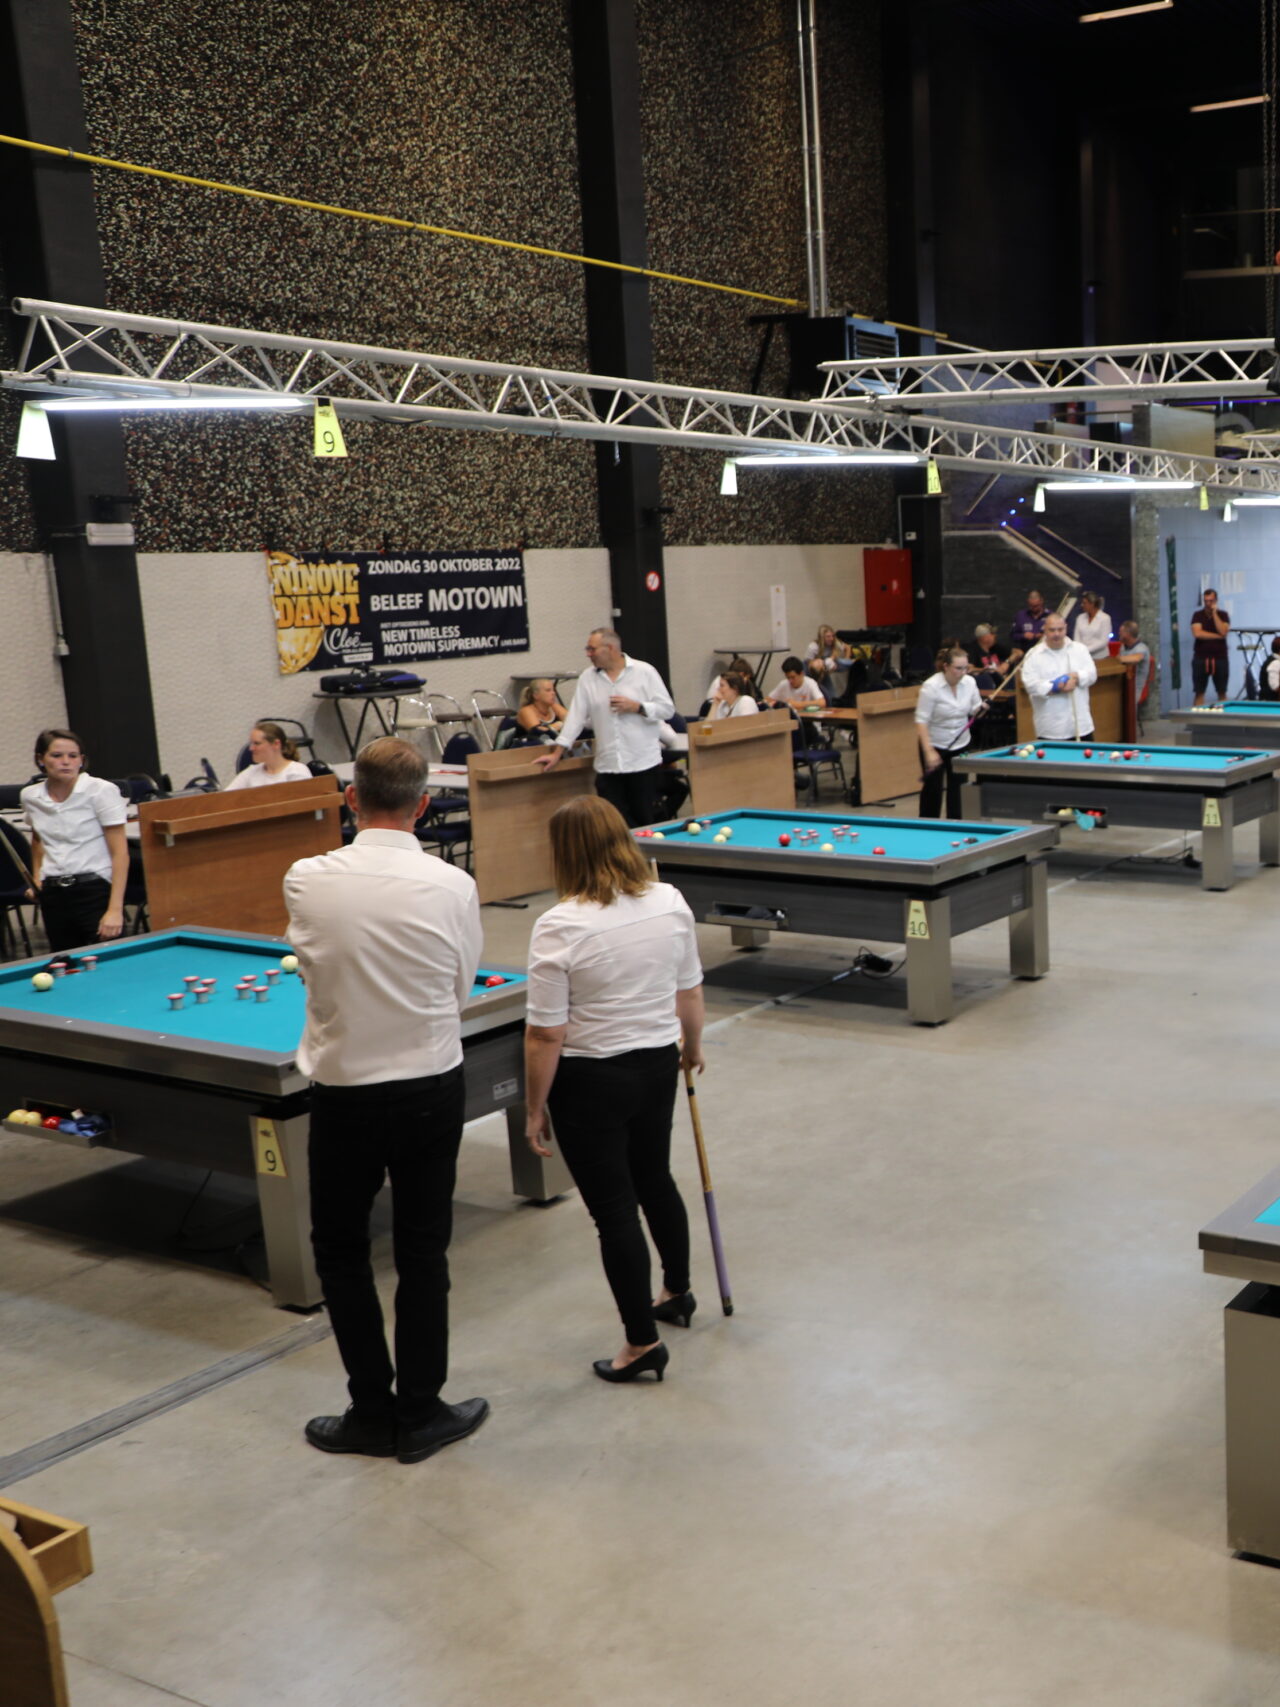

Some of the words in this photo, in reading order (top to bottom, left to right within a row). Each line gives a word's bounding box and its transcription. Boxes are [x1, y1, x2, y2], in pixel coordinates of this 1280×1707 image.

[323, 430, 335, 453] 9
[367, 559, 421, 575] ZONDAG
[423, 560, 438, 573] 30
[439, 558, 493, 573] OKTOBER
[495, 557, 521, 571] 2022
[271, 563, 360, 596] NINOVE
[370, 593, 423, 612] BELEEF
[428, 585, 523, 612] MOTOWN
[275, 594, 360, 629] DANST
[381, 629, 410, 643] NEW
[410, 625, 461, 641] TIMELESS
[383, 641, 437, 657] MOTOWN
[438, 635, 500, 652] SUPREMACY
[1206, 813, 1219, 825] 11
[911, 920, 928, 936] 10
[265, 1149, 277, 1172] 9
